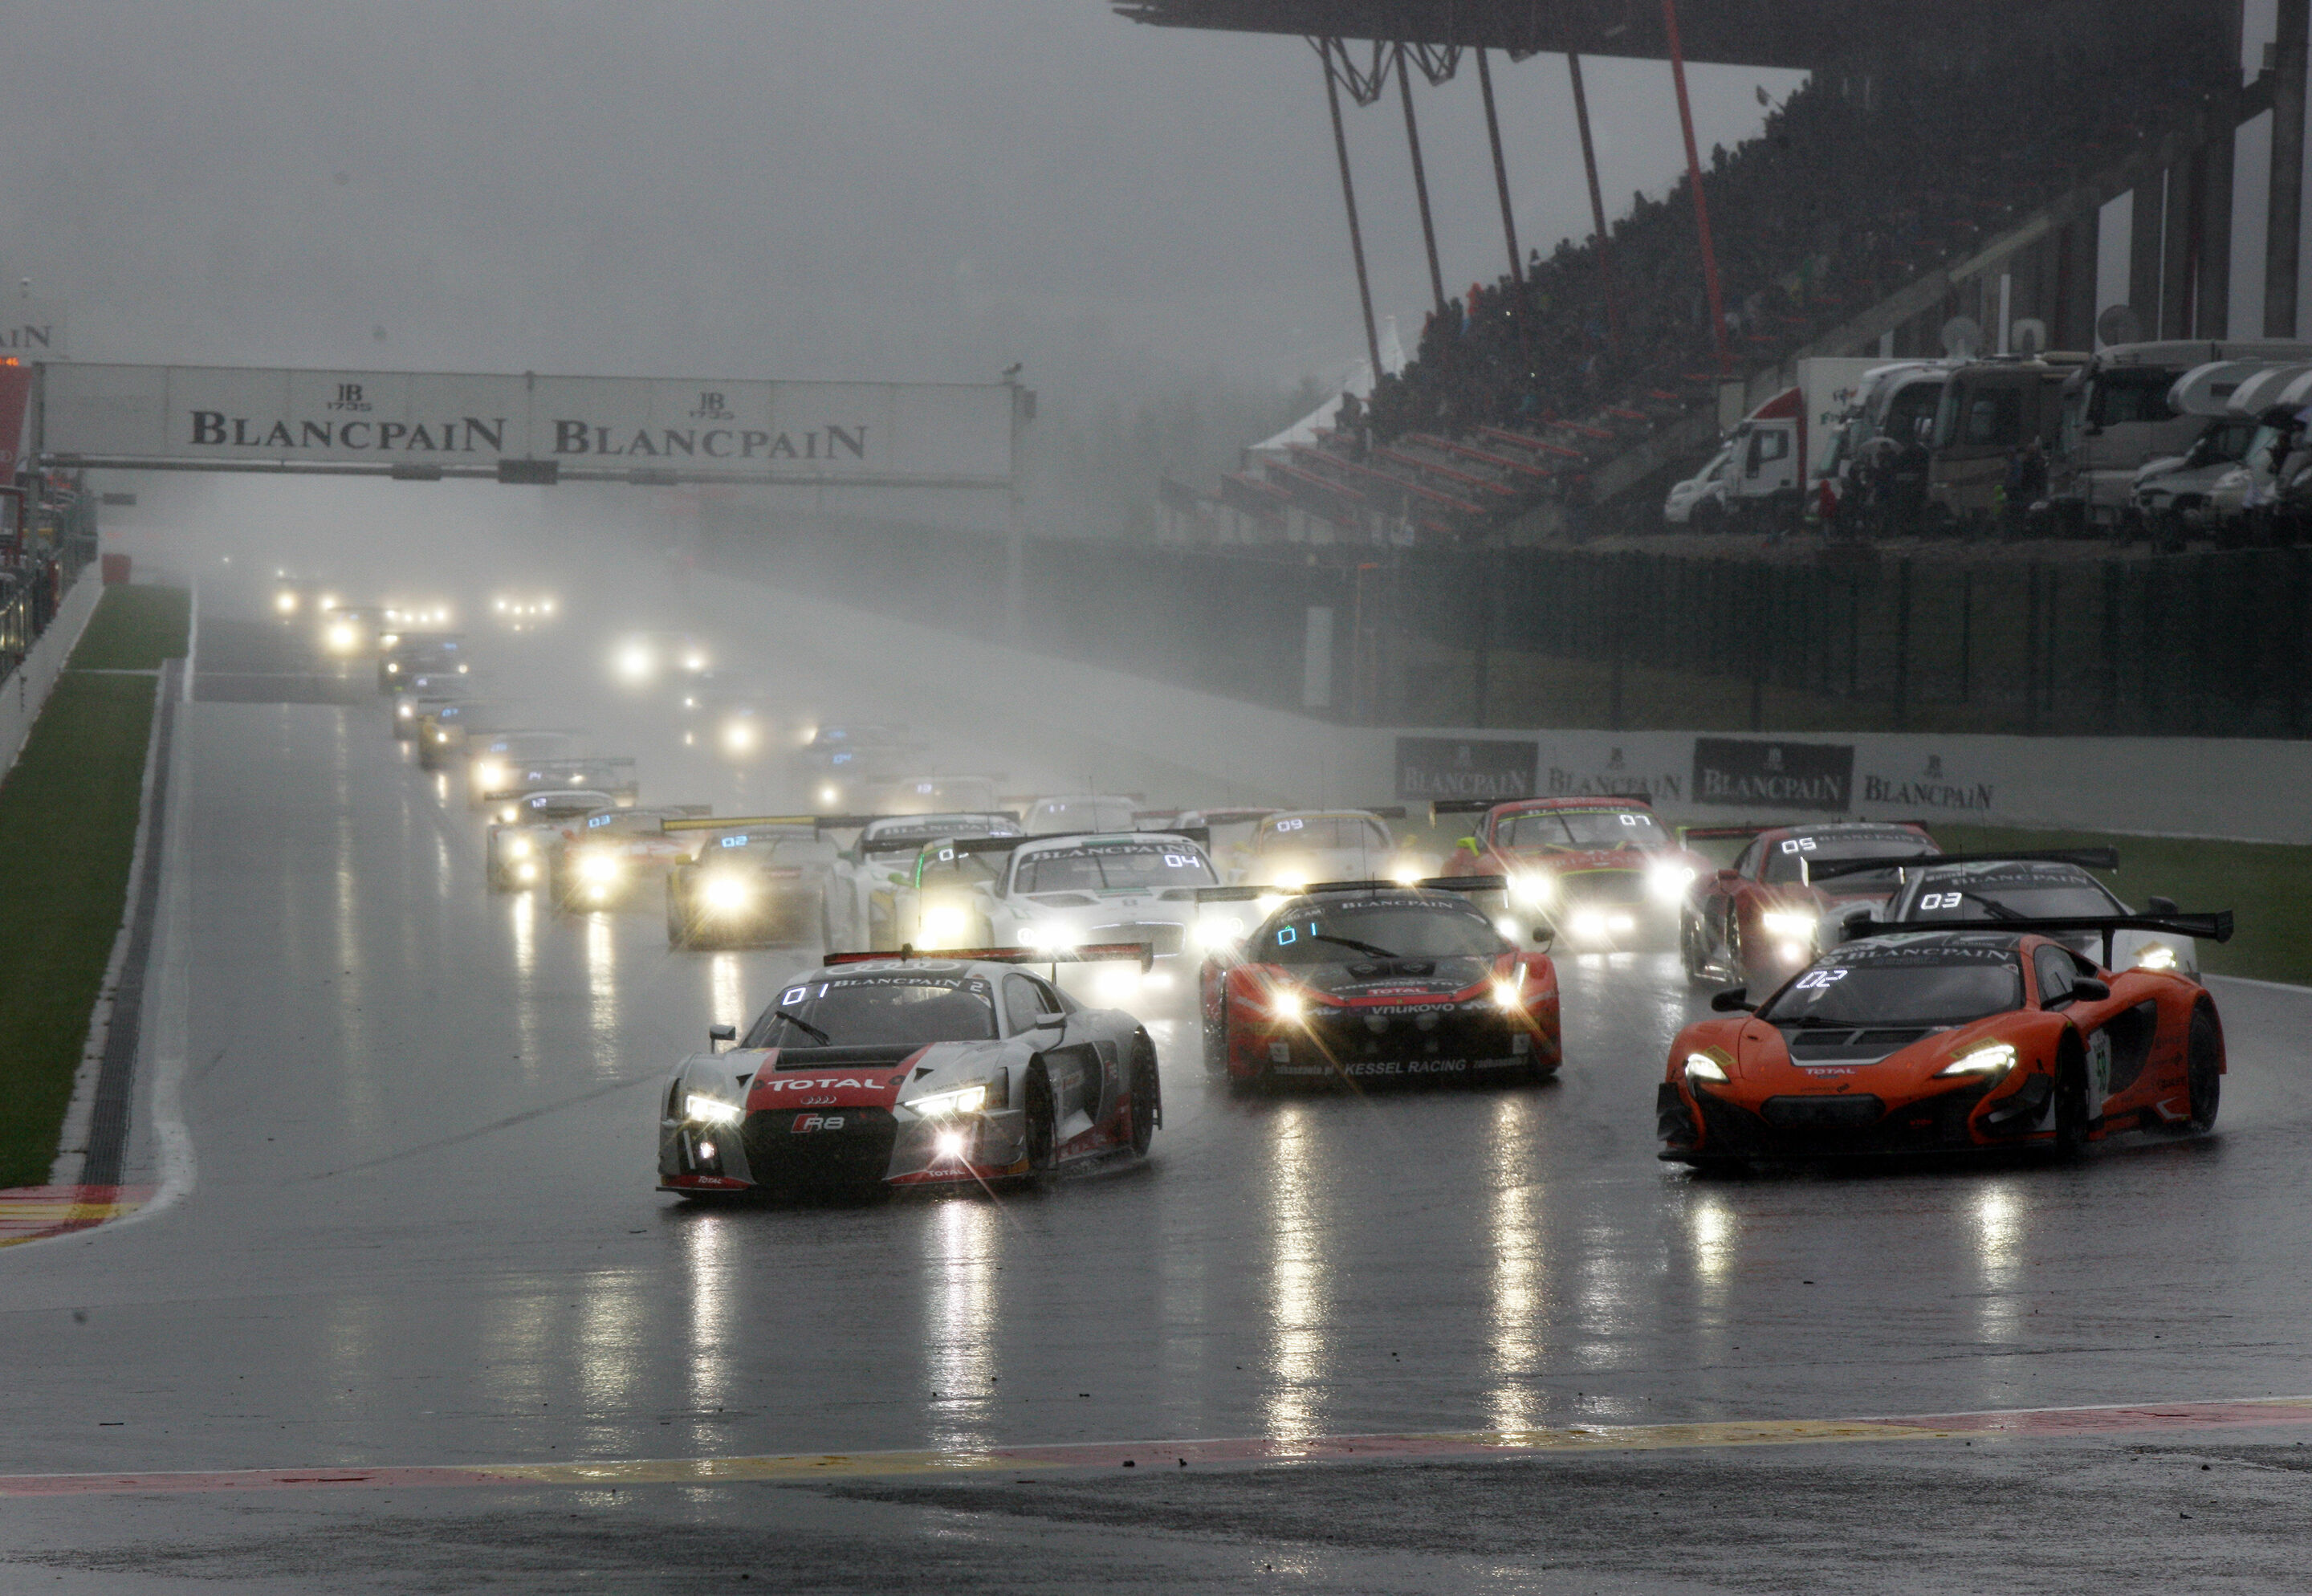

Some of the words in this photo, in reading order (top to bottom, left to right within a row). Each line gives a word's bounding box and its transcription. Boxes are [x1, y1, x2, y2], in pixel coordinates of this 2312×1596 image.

[189, 410, 507, 452] BLANCPAIN
[553, 419, 868, 460] BLANCPAIN
[1403, 767, 1528, 797] BLANCPAIN
[1549, 767, 1683, 801] BLANCPAIN
[1704, 768, 1841, 803] BLANCPAIN
[1866, 775, 1993, 810] BLANCPAIN
[1276, 819, 1304, 833] 09
[1618, 813, 1651, 826] 07
[722, 835, 748, 849] 02
[1781, 837, 1817, 854] 05
[1032, 845, 1186, 861] BLANCPAIN
[1164, 854, 1199, 868] 04
[1341, 900, 1453, 910] BLANCPAIN
[1920, 892, 1962, 910] 03
[1846, 947, 2011, 963] BLANCPAIN
[833, 978, 962, 989] BLANCPAIN
[970, 980, 984, 993] 2
[1796, 968, 1848, 989] 02
[1369, 987, 1427, 995] TOTAL
[1345, 1063, 1403, 1076] KESSEL
[1407, 1059, 1467, 1073] RACING
[1805, 1068, 1856, 1076] TOTAL
[767, 1077, 885, 1092] TOTAL
[798, 1115, 845, 1131] R8
[698, 1175, 722, 1184] TOTAL
[929, 1169, 966, 1178] TOTAL
